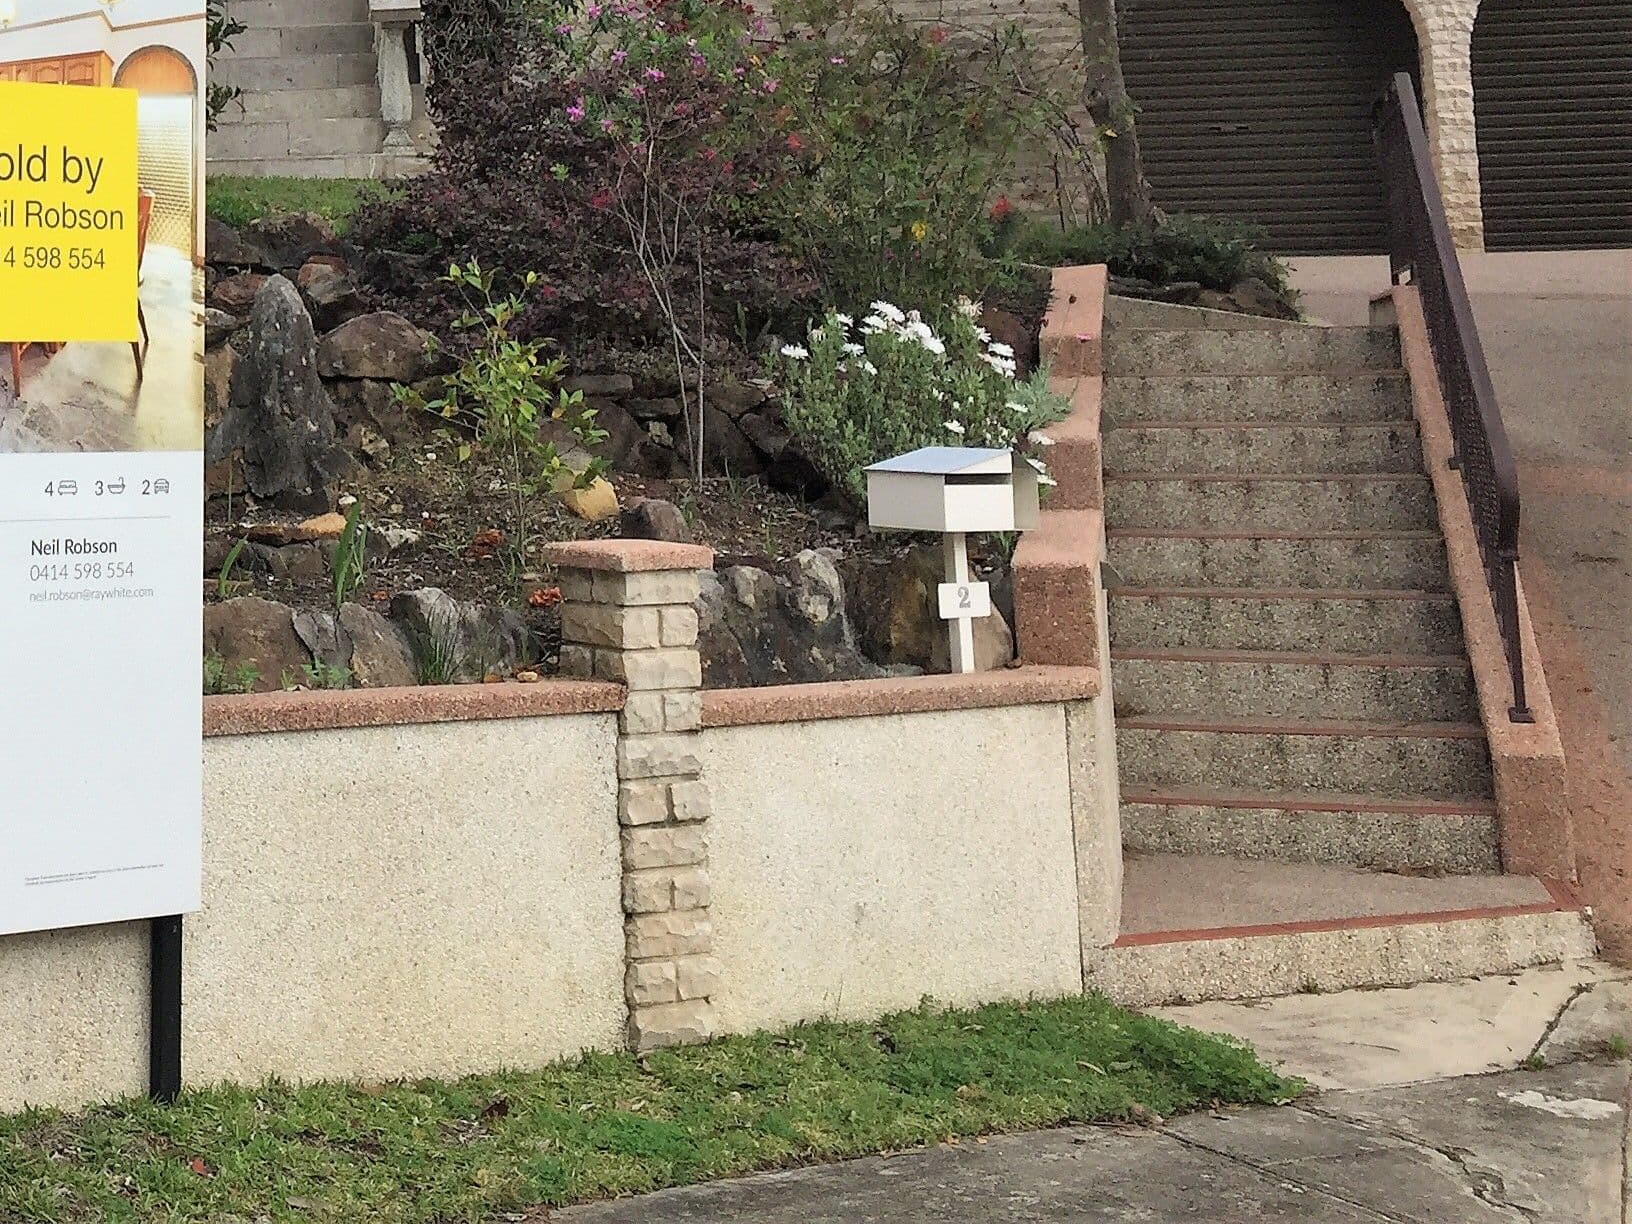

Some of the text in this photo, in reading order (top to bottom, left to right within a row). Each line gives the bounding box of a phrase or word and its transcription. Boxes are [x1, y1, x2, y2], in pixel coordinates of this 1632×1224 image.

[63, 146, 103, 194] by
[26, 200, 123, 229] Robson
[24, 247, 61, 268] 598
[69, 248, 105, 269] 554
[45, 480, 150, 496] 4 3 2
[31, 538, 117, 555] Neil Robson
[30, 562, 134, 581] 0414 598 554
[958, 586, 971, 608] 2
